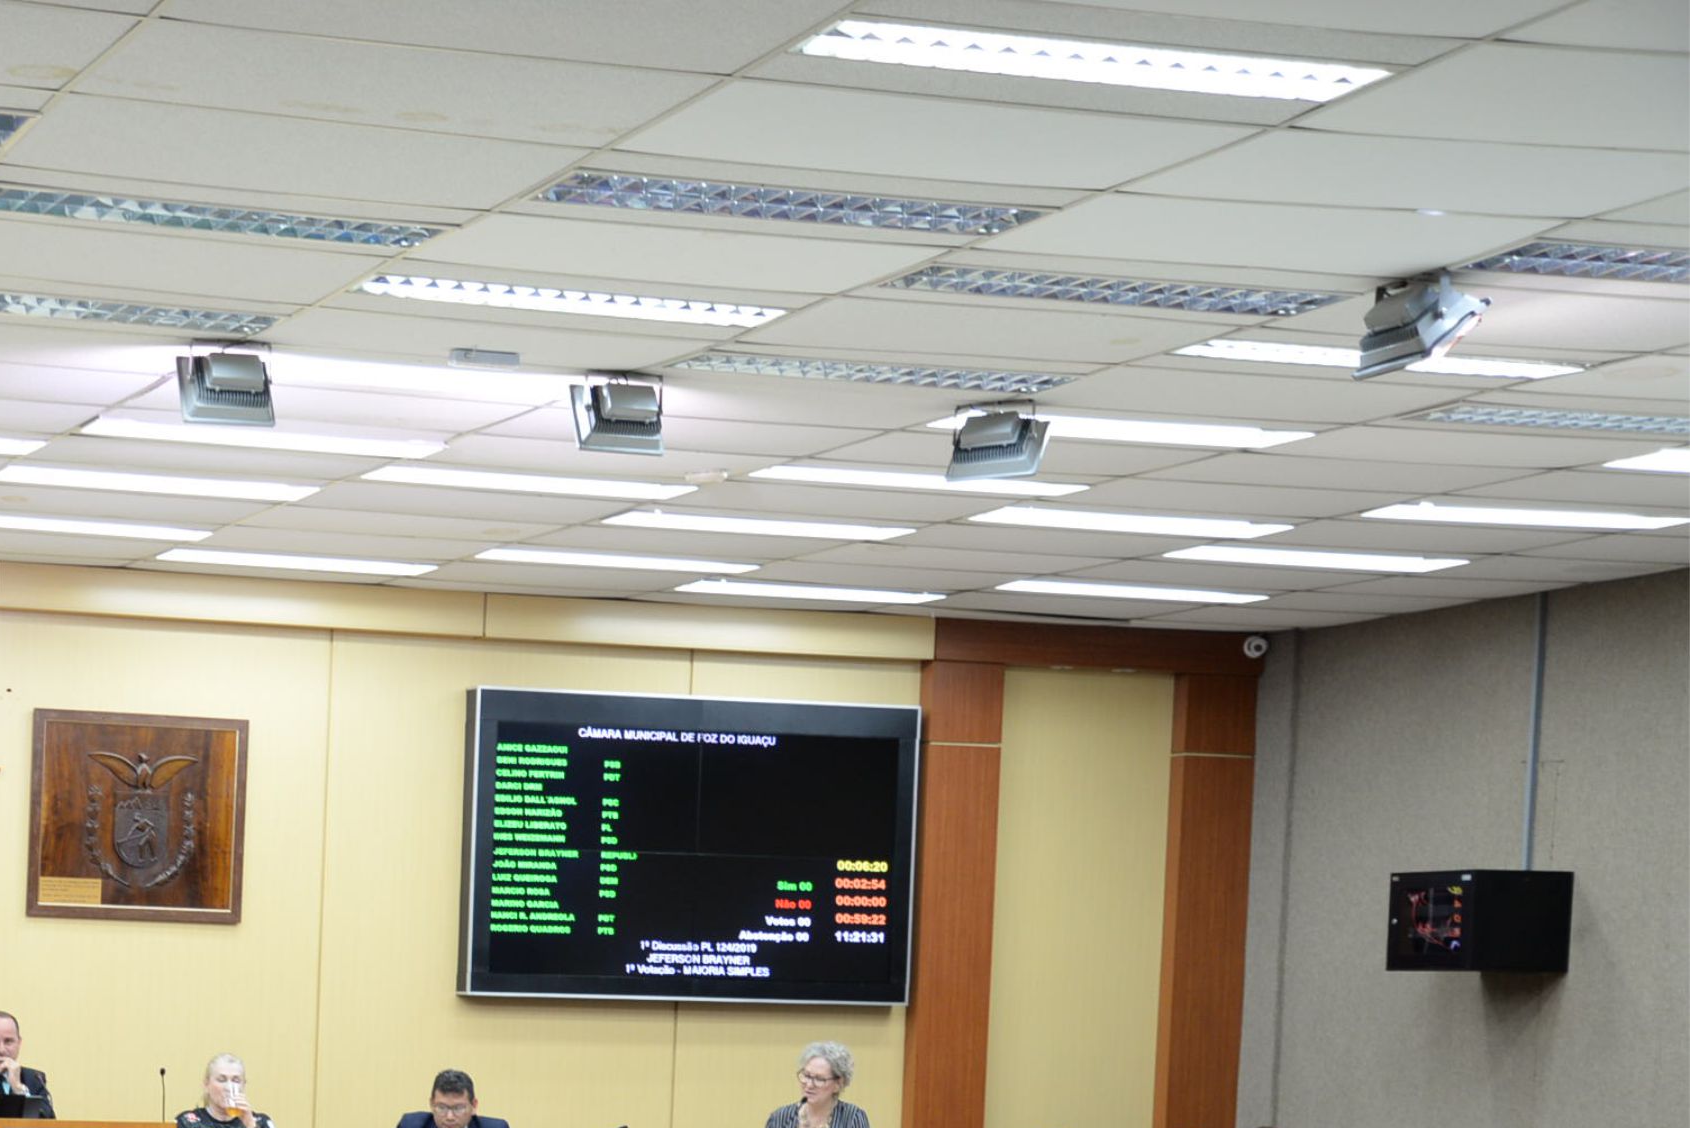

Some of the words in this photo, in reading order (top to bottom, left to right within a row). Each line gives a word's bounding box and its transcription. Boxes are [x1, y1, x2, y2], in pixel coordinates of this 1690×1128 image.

[578, 726, 622, 739] CÂMARA
[624, 729, 678, 742] MUNICIPAL
[681, 732, 695, 743] DE
[720, 734, 735, 744] DO
[737, 735, 776, 748] IGUAÇU
[836, 860, 888, 873] 00:06:20
[776, 881, 797, 891] Sim
[835, 877, 886, 890] 00:02:54
[775, 898, 796, 909] Não
[835, 895, 886, 907] 00:00:00
[764, 915, 796, 926] Votos
[835, 913, 886, 925] 00:59:22
[834, 930, 885, 943] 11:21:31
[646, 953, 700, 964] JEFERSON
[701, 954, 751, 965] BRAYNER
